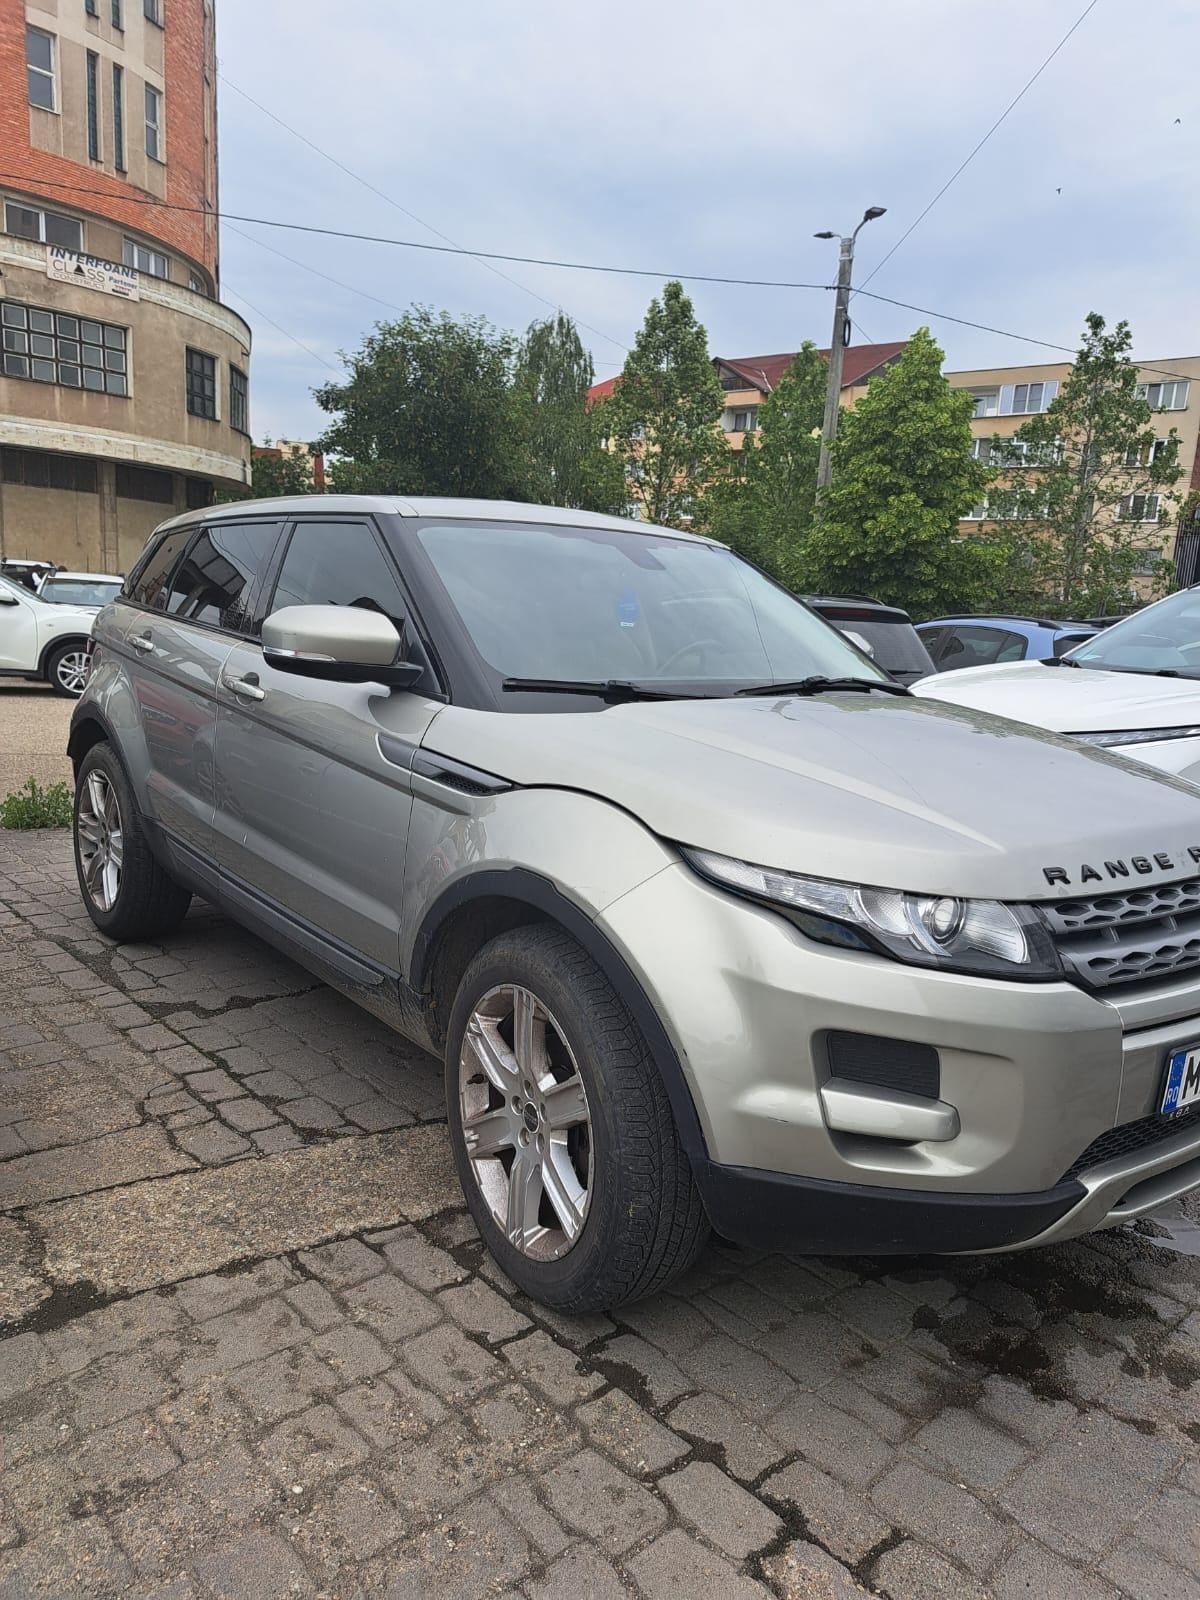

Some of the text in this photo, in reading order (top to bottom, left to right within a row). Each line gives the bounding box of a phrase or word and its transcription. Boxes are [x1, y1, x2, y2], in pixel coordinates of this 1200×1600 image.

[50, 247, 138, 280] INTERFOANE
[1042, 852, 1175, 885] RANGE
[1166, 1087, 1179, 1104] RO
